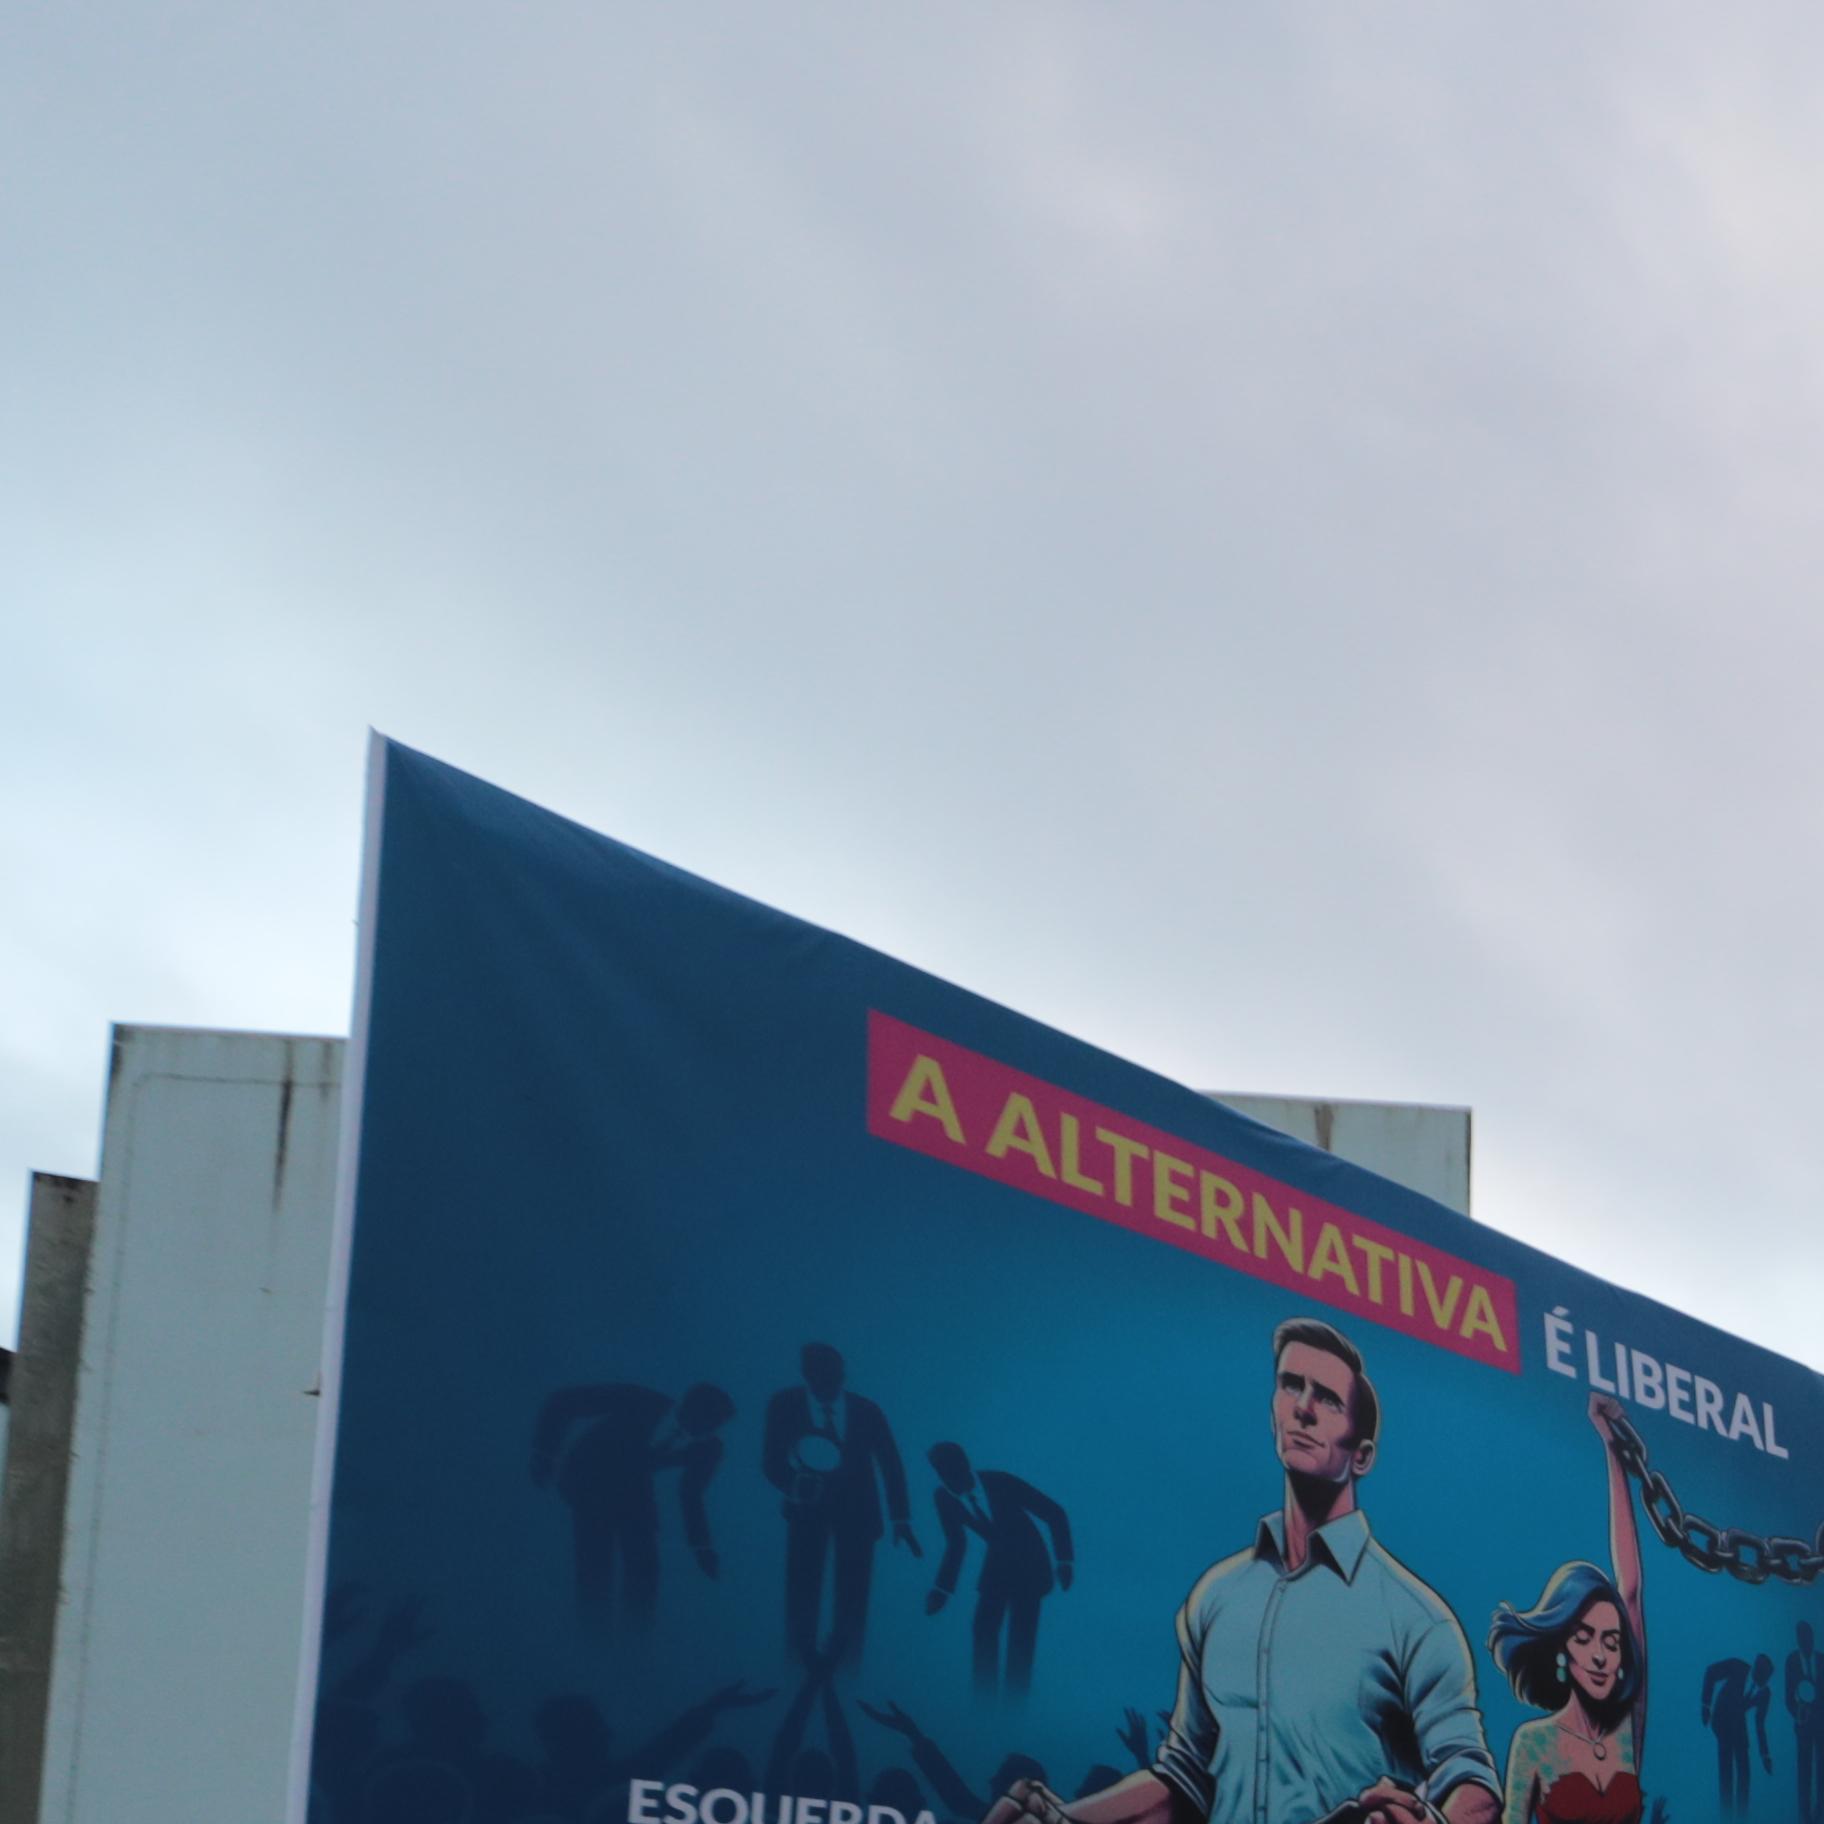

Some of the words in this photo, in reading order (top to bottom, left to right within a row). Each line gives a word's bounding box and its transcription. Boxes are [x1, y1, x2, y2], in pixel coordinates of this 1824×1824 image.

[889, 1052, 967, 1144] A
[985, 1091, 1508, 1352] ALTERNATIVA
[1543, 1306, 1578, 1379] É
[1585, 1329, 1790, 1459] LIBERAL
